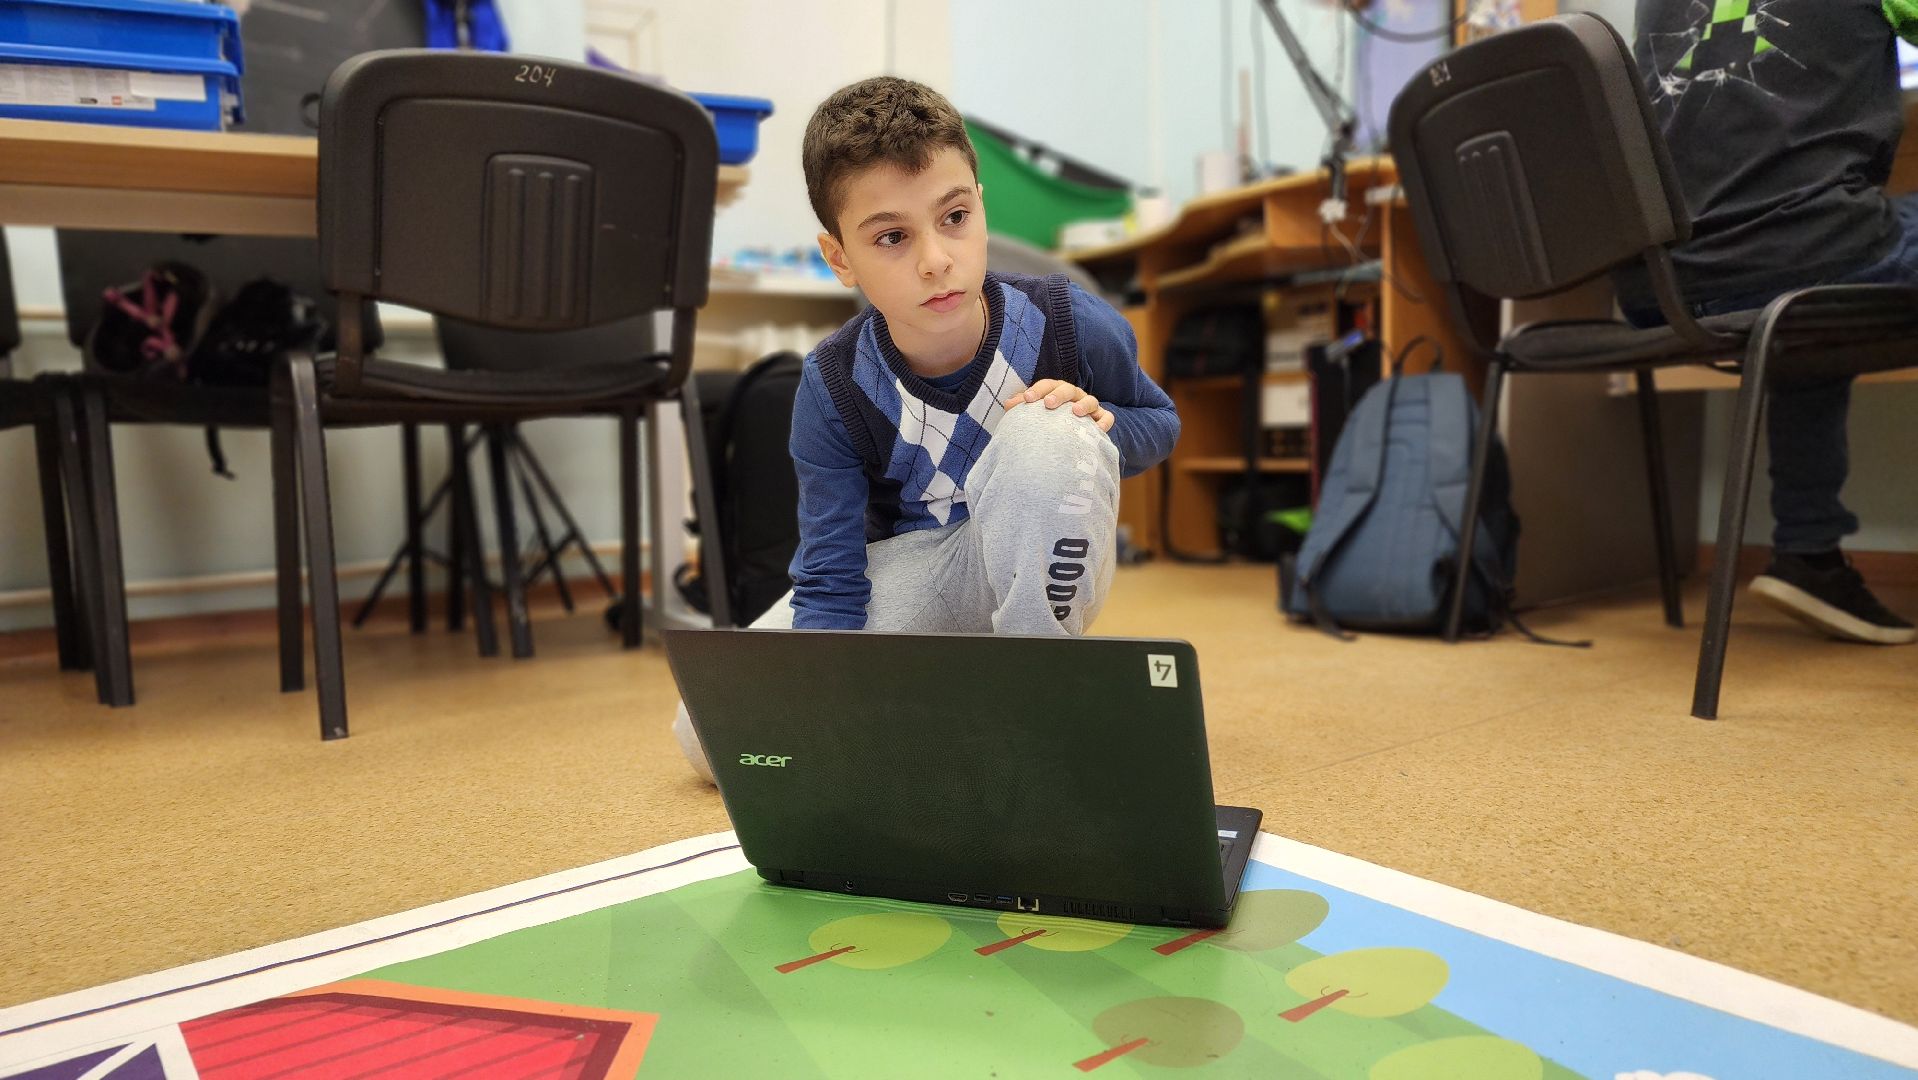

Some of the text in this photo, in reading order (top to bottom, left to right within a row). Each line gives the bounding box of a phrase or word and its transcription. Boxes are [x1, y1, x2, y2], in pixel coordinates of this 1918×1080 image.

[514, 64, 557, 88] 204
[1153, 659, 1172, 681] 4
[739, 753, 793, 768] acer
